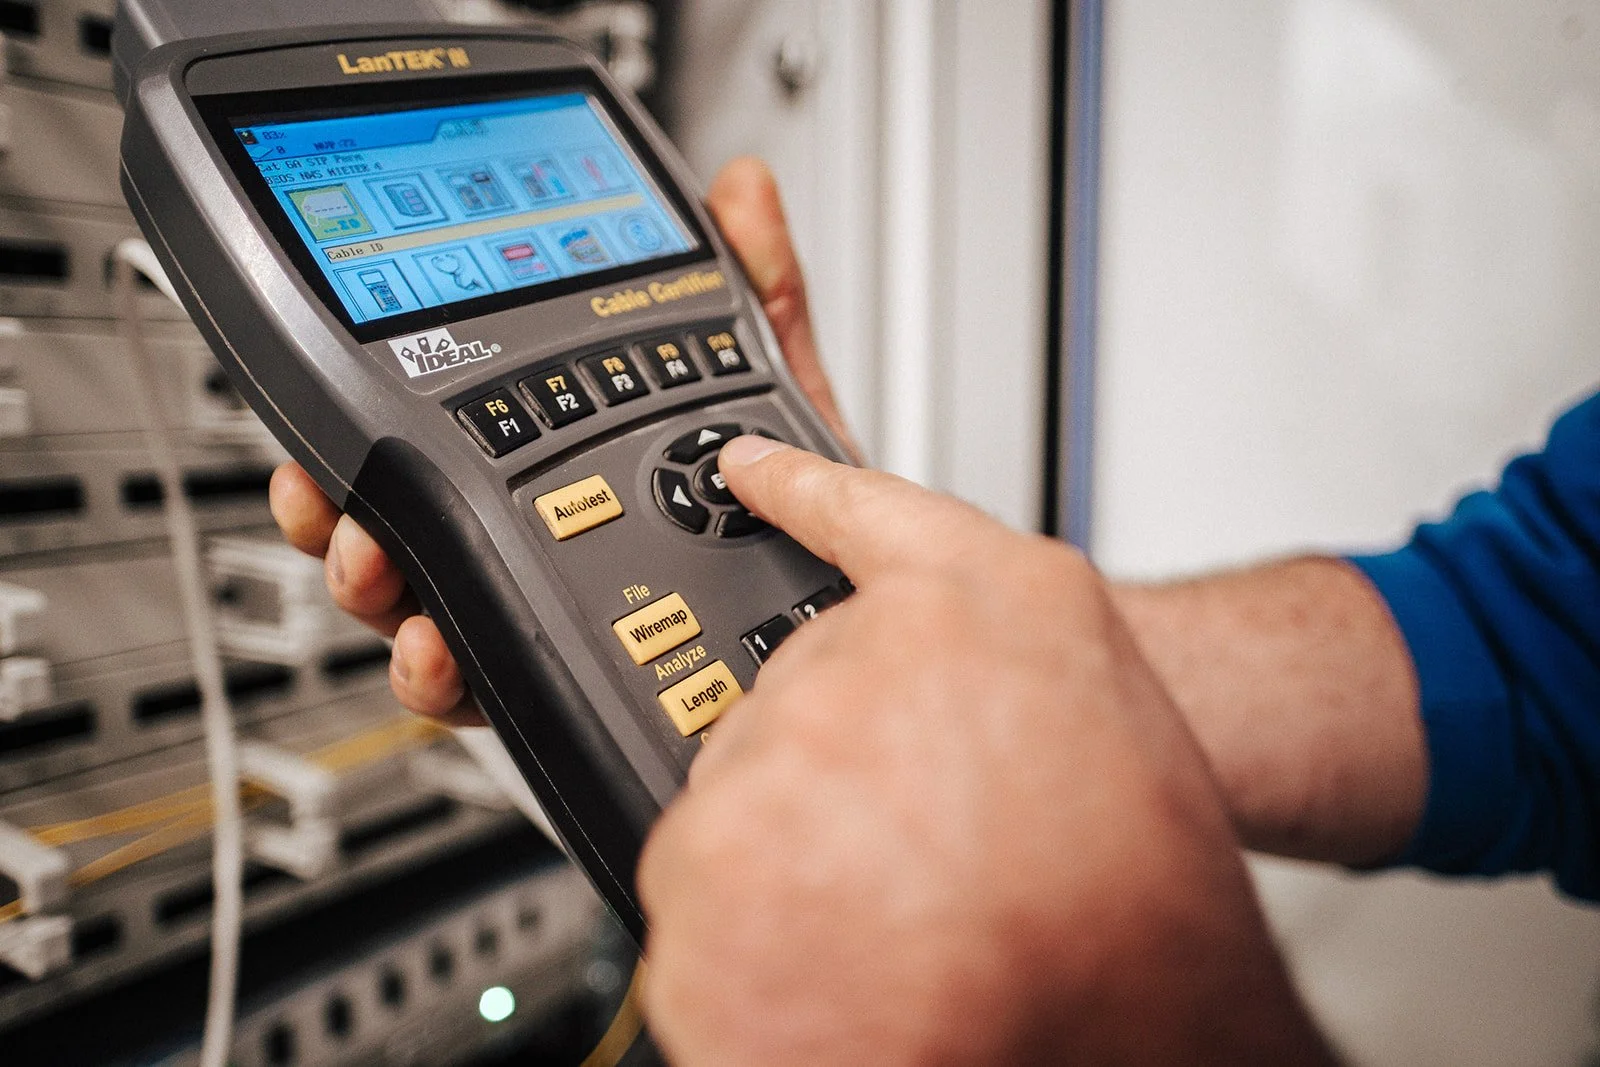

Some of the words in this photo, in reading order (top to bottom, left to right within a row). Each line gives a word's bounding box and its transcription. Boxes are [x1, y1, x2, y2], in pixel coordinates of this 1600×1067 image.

[257, 162, 281, 173] Cat
[285, 159, 302, 170] 6A
[306, 157, 327, 167] STP
[327, 246, 364, 260] Cable
[370, 243, 384, 253] ID
[591, 289, 652, 318] Cable
[648, 270, 724, 303] Certifier
[656, 343, 680, 361] F9
[601, 357, 626, 374] F8
[665, 360, 689, 378] F4
[545, 376, 566, 393] F7
[611, 374, 635, 392] F3
[485, 399, 509, 417] F6
[554, 393, 580, 413] F2
[497, 420, 520, 437] F1
[552, 488, 611, 523] Autotest
[622, 582, 651, 605] File
[629, 607, 688, 644] Wiremap
[755, 633, 768, 651] 1
[653, 643, 707, 681] Analyze
[680, 677, 728, 712] Length
